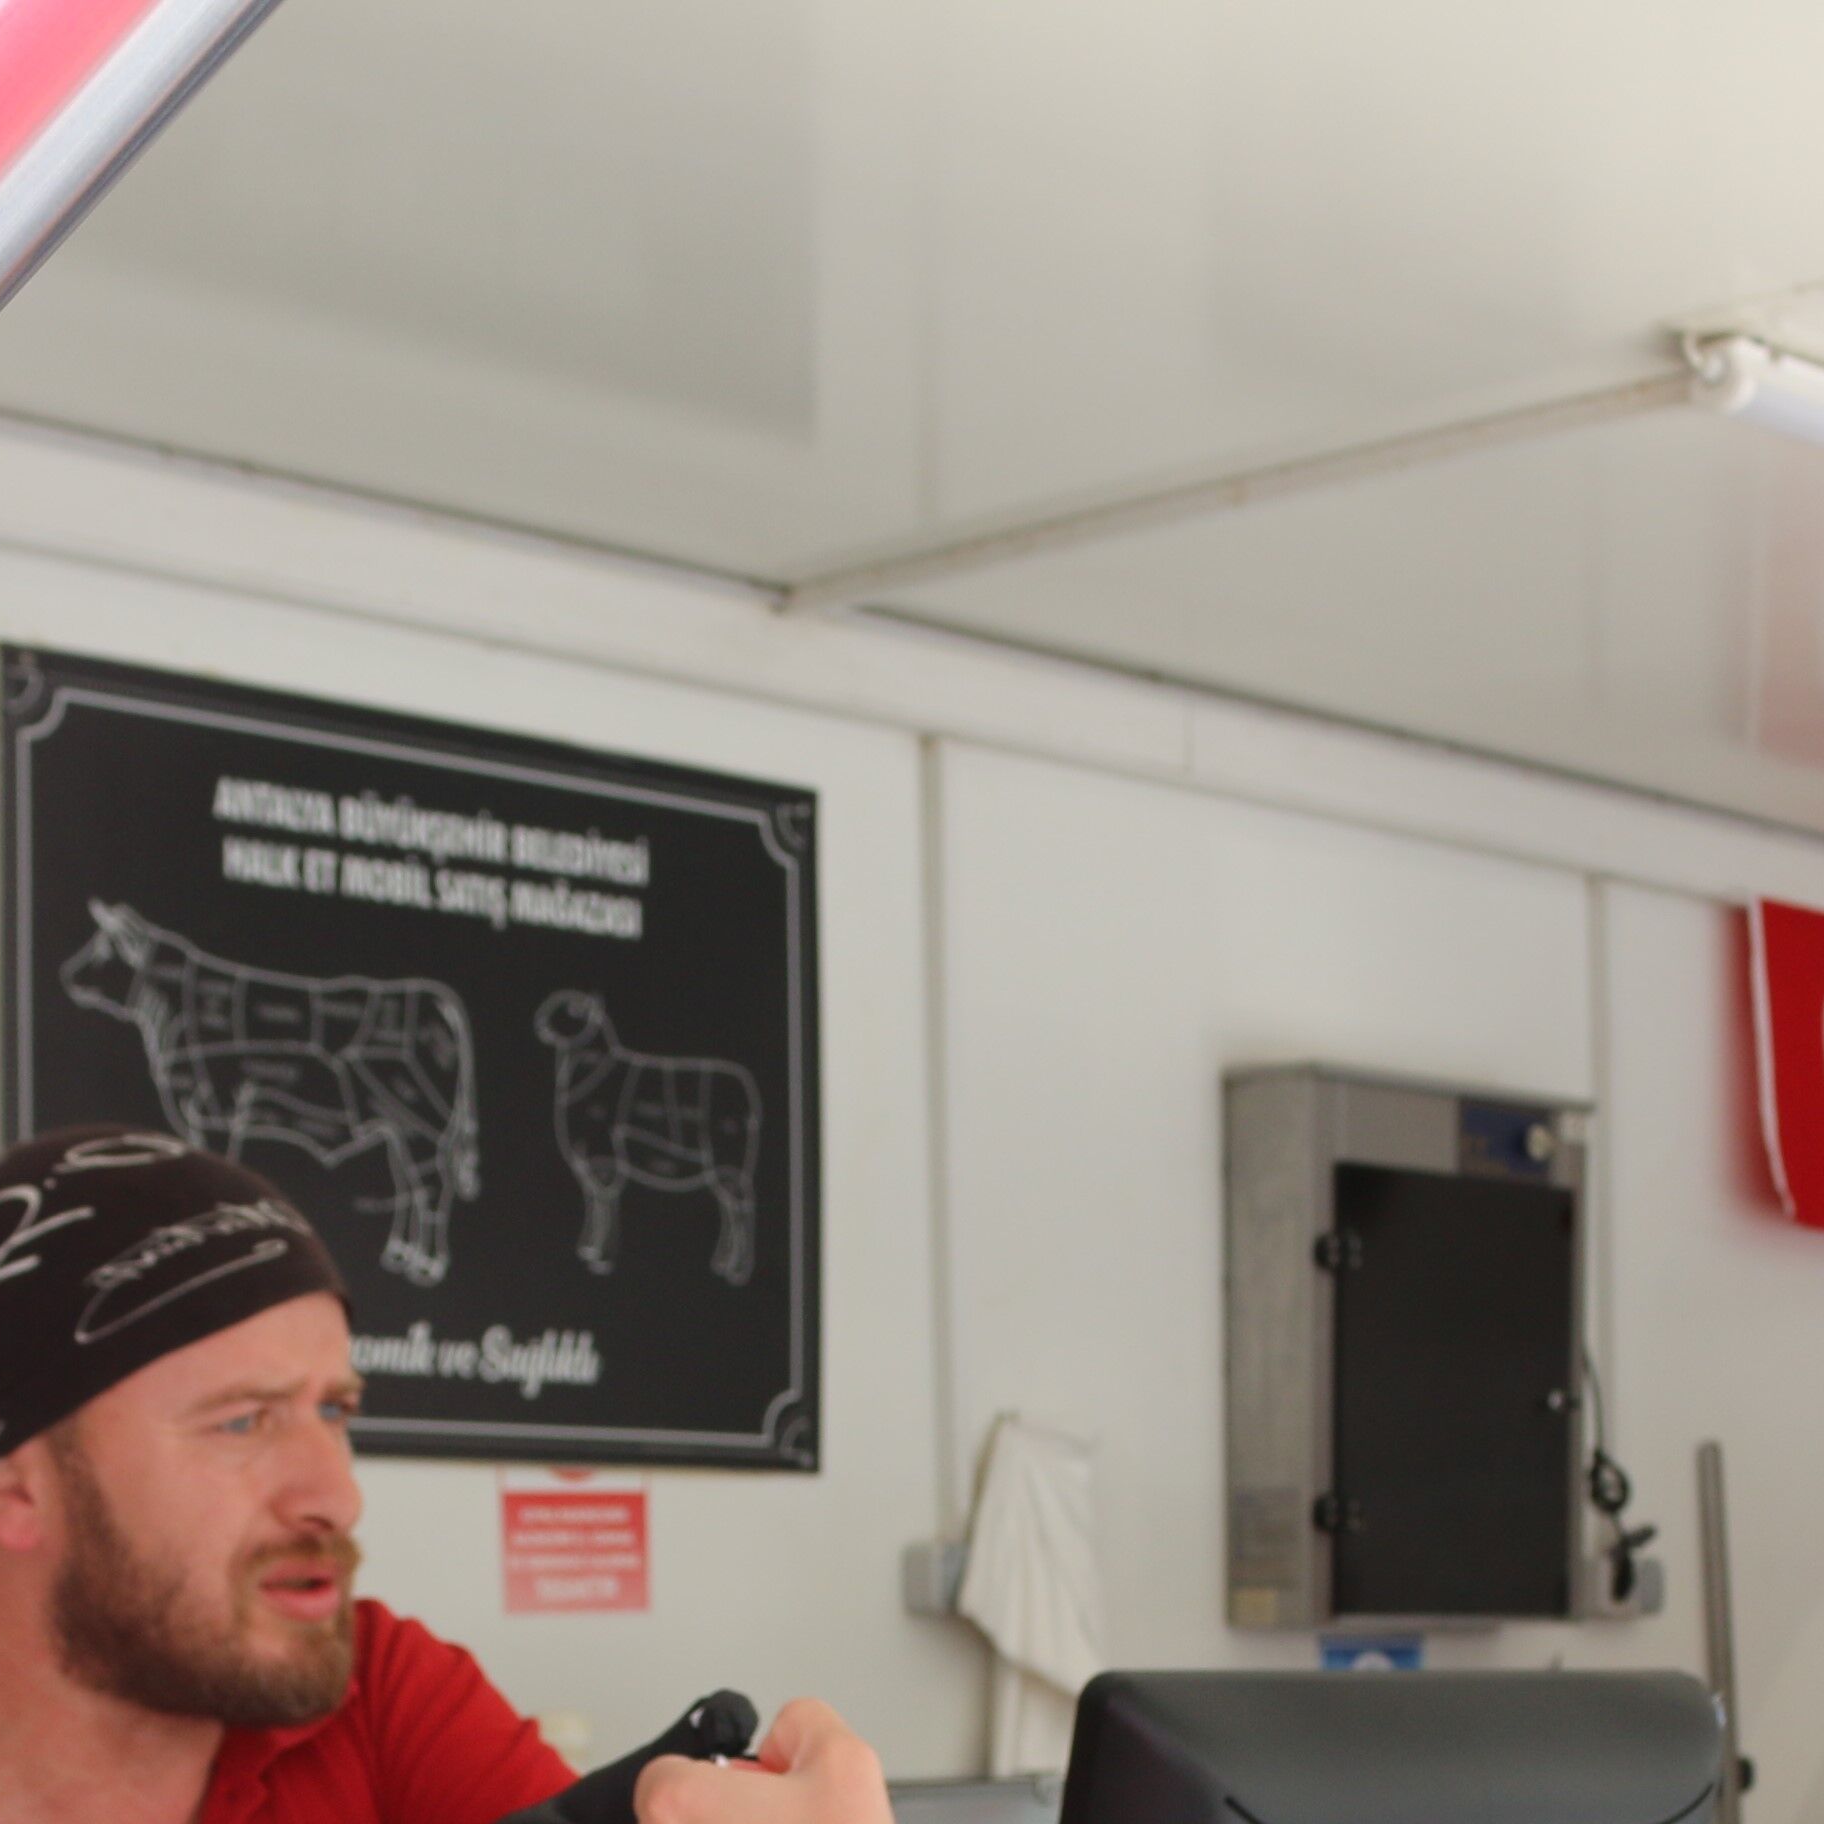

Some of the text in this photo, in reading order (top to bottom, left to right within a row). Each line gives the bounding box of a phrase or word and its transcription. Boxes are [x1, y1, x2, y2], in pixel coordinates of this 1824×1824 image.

[212, 776, 336, 837] ANTALYA
[222, 836, 300, 889] HALK
[302, 848, 339, 895] ET
[436, 1340, 478, 1380] ve
